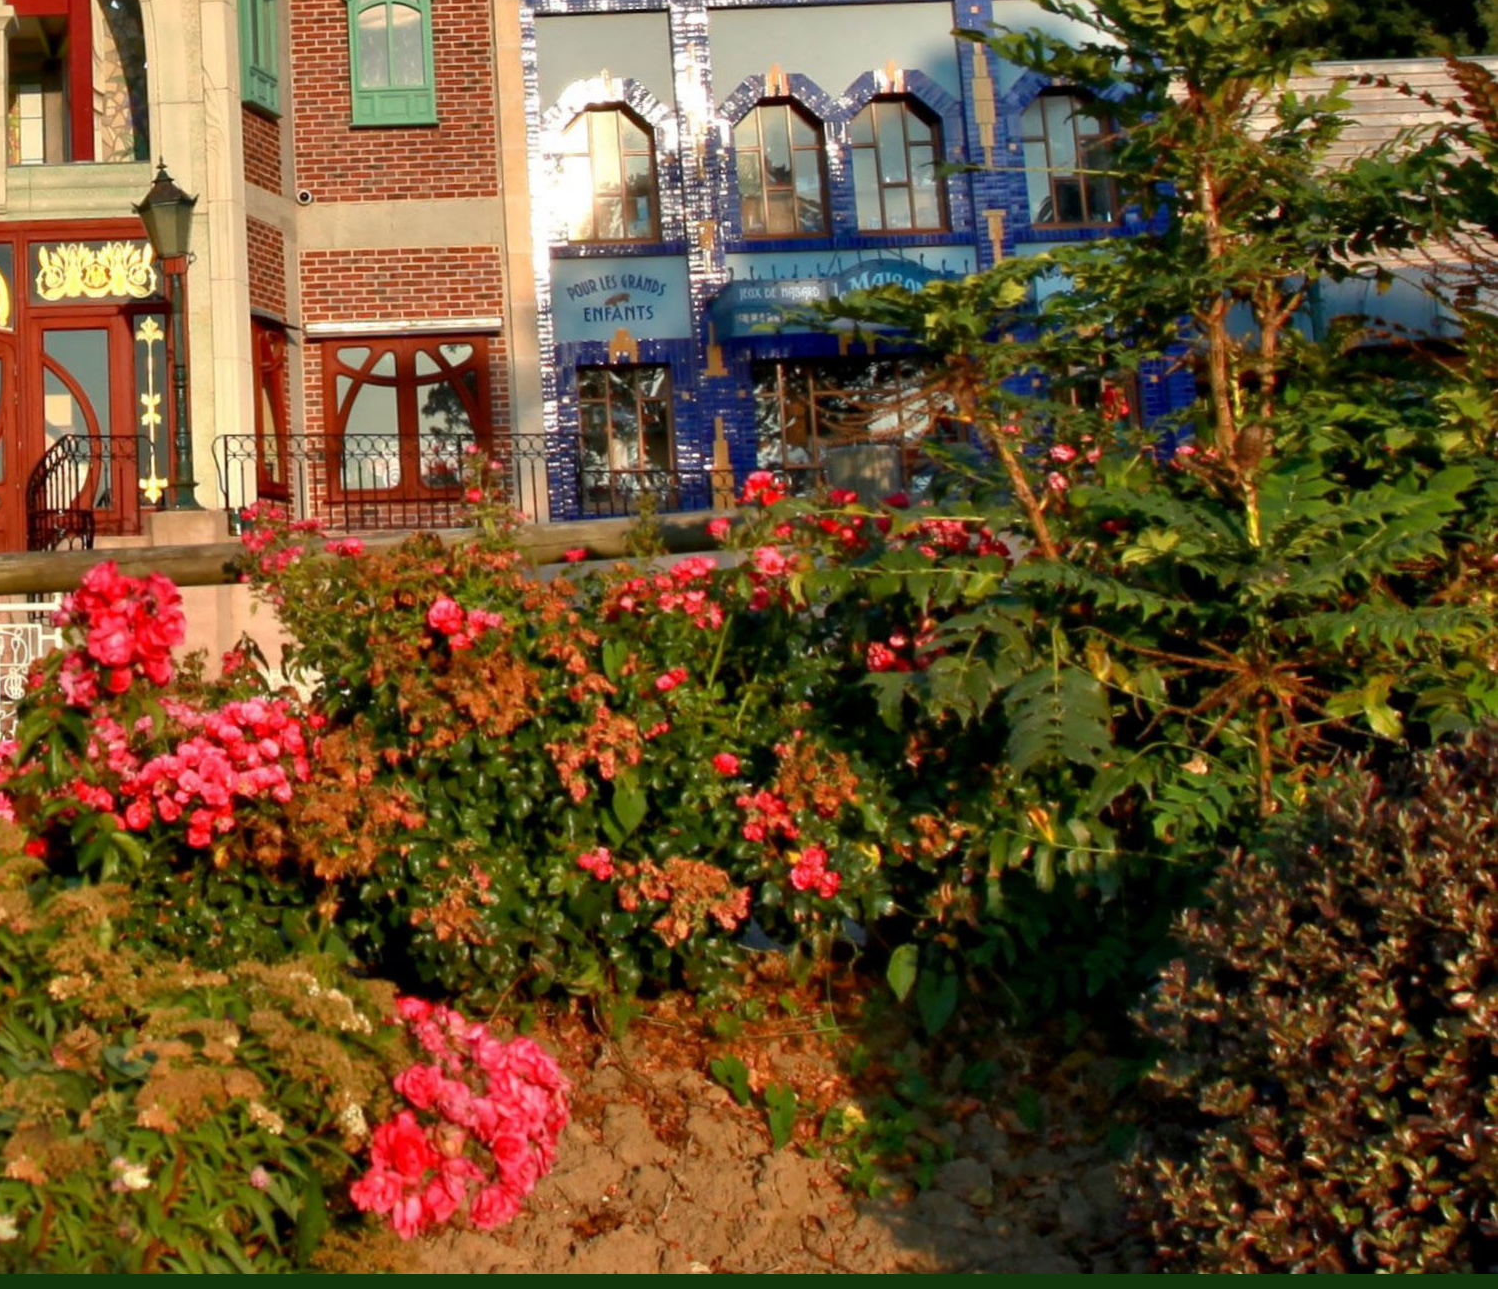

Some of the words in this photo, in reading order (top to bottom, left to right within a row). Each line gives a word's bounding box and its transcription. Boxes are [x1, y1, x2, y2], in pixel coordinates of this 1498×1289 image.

[566, 279, 598, 301] POUR
[599, 274, 617, 291] LES
[621, 274, 667, 296] GRANDS
[583, 305, 655, 322] ENFANTS
